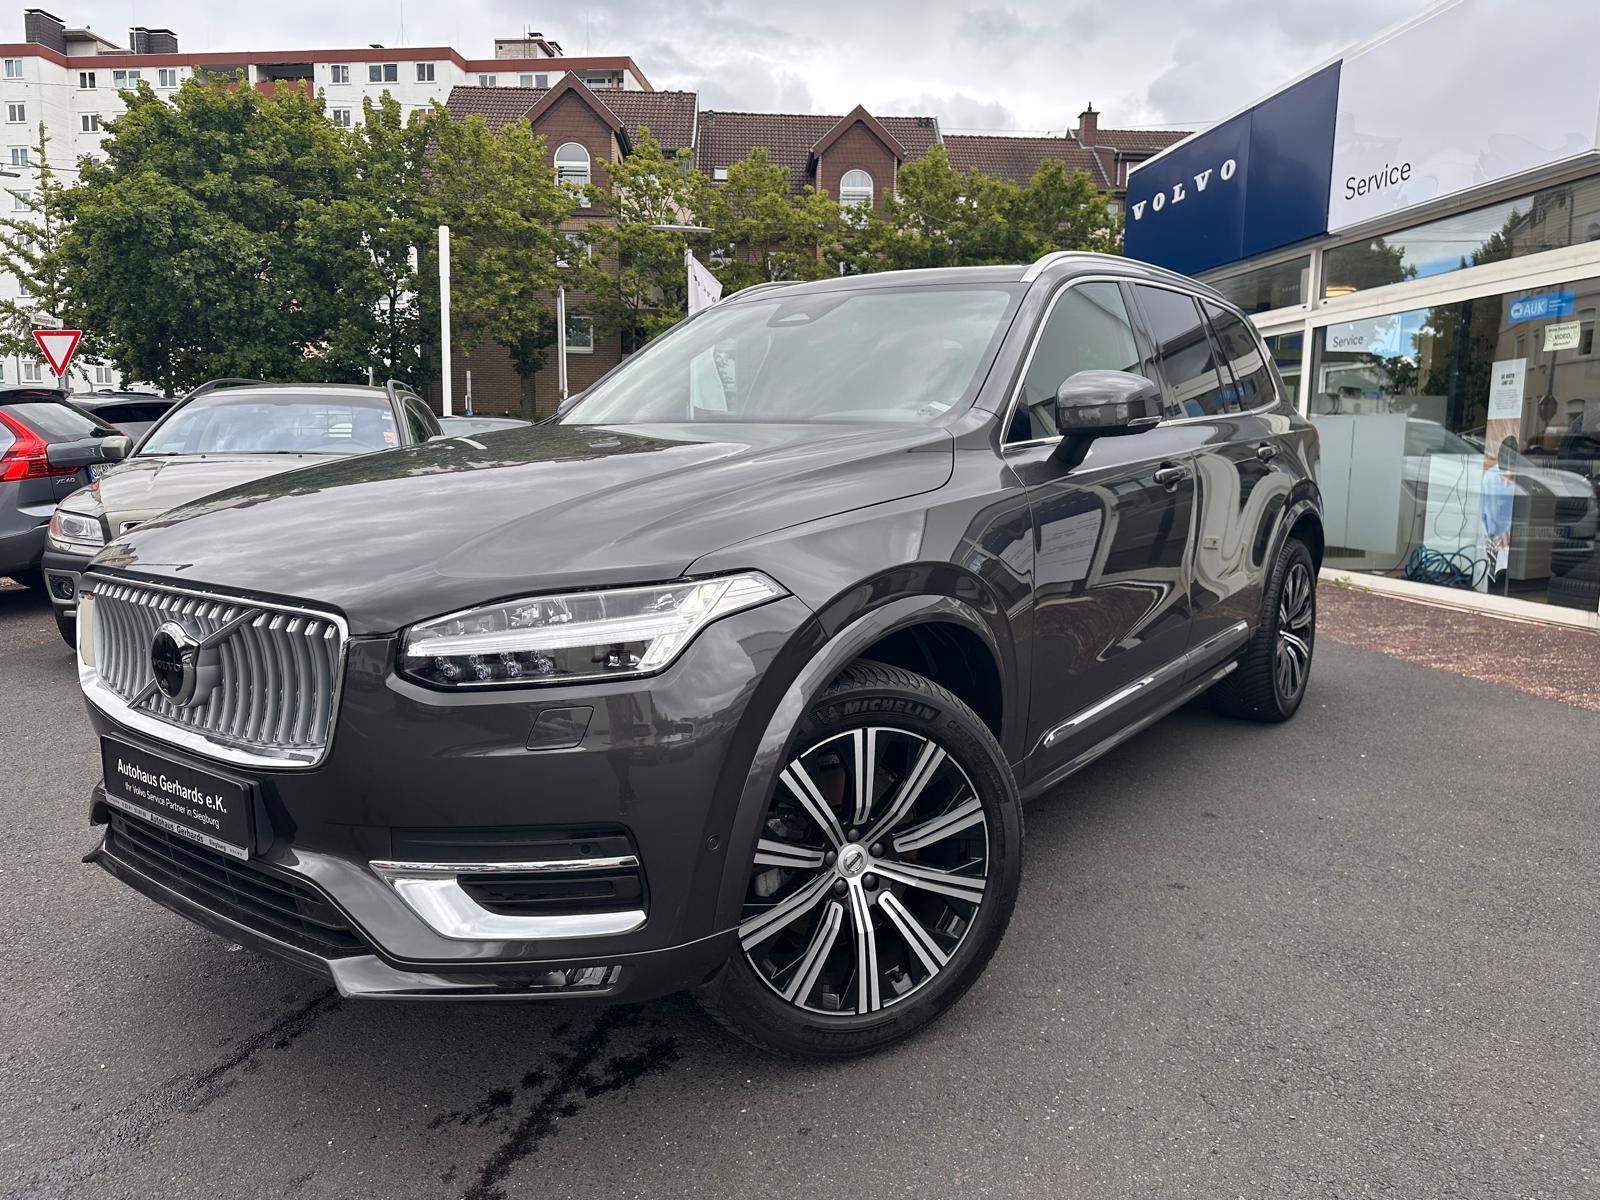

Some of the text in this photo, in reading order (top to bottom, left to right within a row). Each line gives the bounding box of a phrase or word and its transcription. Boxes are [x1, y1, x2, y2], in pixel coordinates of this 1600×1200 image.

[1131, 159, 1236, 221] VOLVO
[1344, 162, 1411, 200] Service
[1332, 334, 1364, 348] Service
[842, 699, 937, 721] MICHELIN
[117, 758, 227, 814] Autohaus Gerhards e.K.
[132, 784, 147, 798] Volvo
[146, 790, 166, 806] Service
[165, 798, 186, 814] Partner
[192, 808, 220, 830] Siegburg
[150, 813, 174, 831] Autohaus
[176, 825, 204, 843] Gerhards
